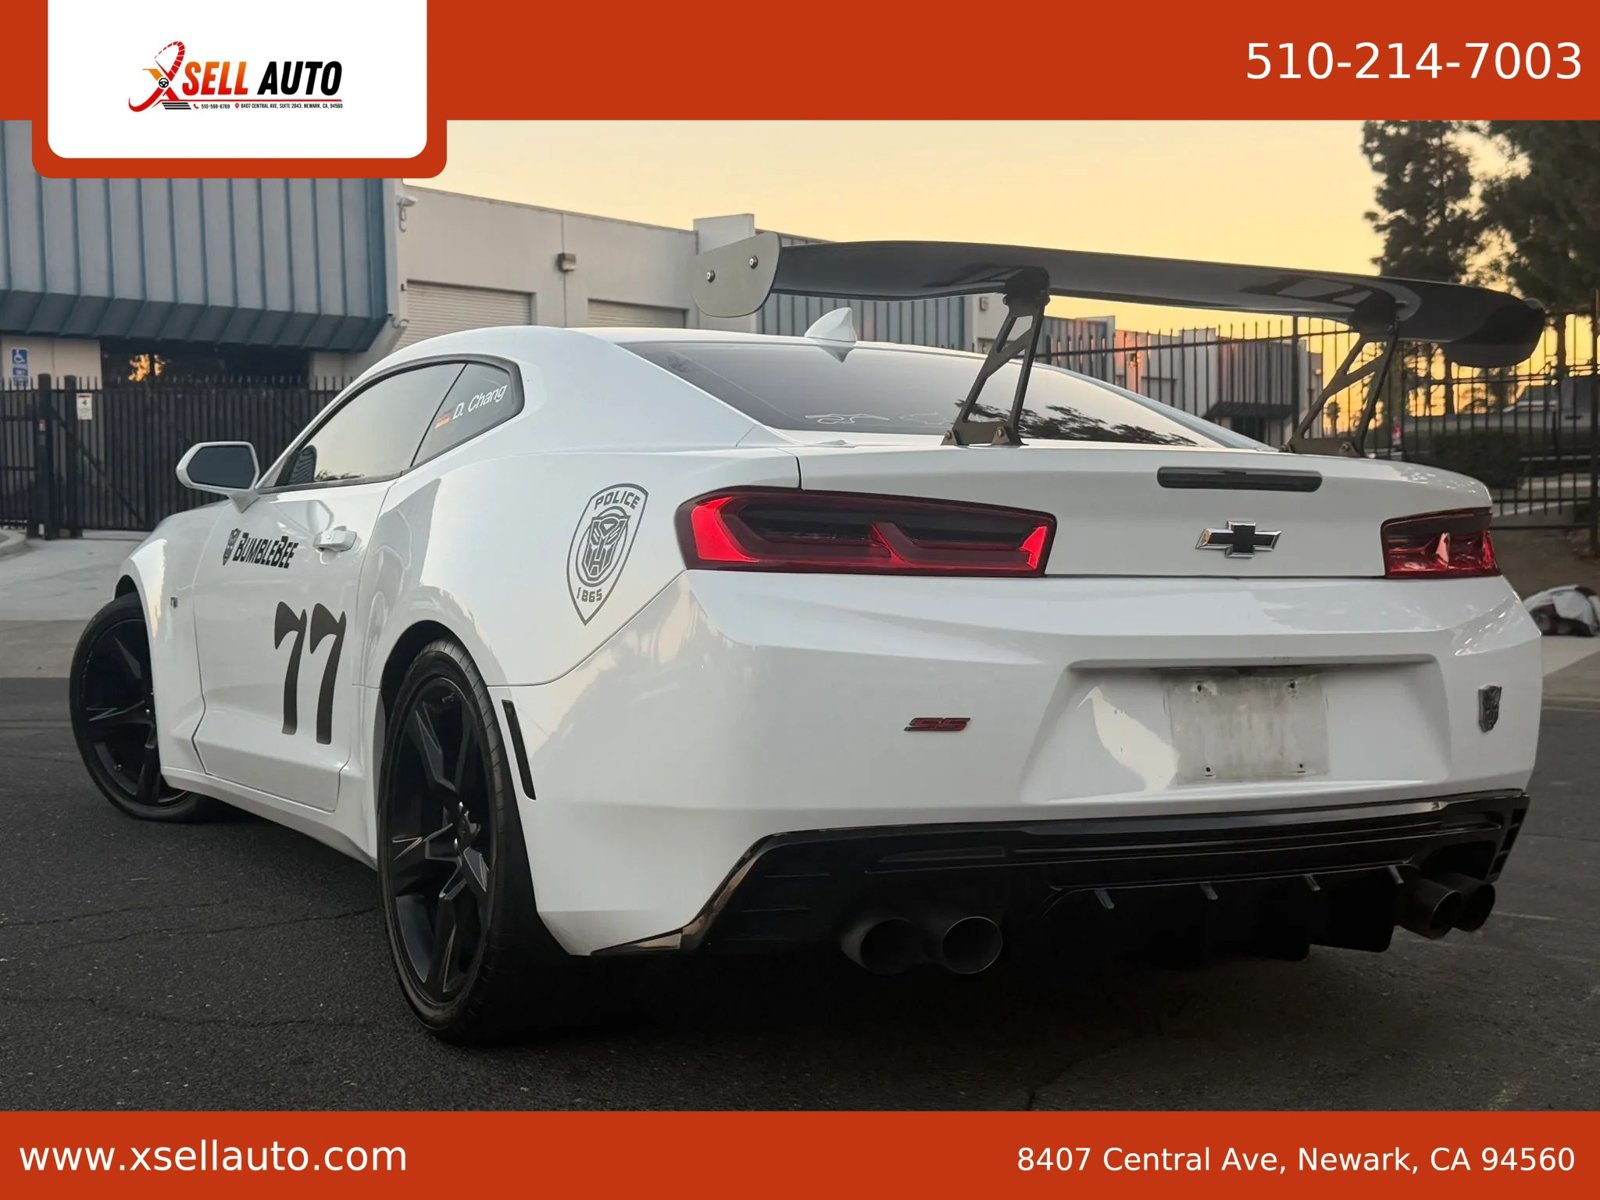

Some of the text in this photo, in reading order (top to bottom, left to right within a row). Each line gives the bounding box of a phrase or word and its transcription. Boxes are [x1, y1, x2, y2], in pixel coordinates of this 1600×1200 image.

[452, 384, 508, 420] D. Chang
[594, 490, 641, 511] POLICE
[576, 587, 603, 603] 1865
[274, 601, 347, 744] 77
[904, 717, 971, 732] SS
